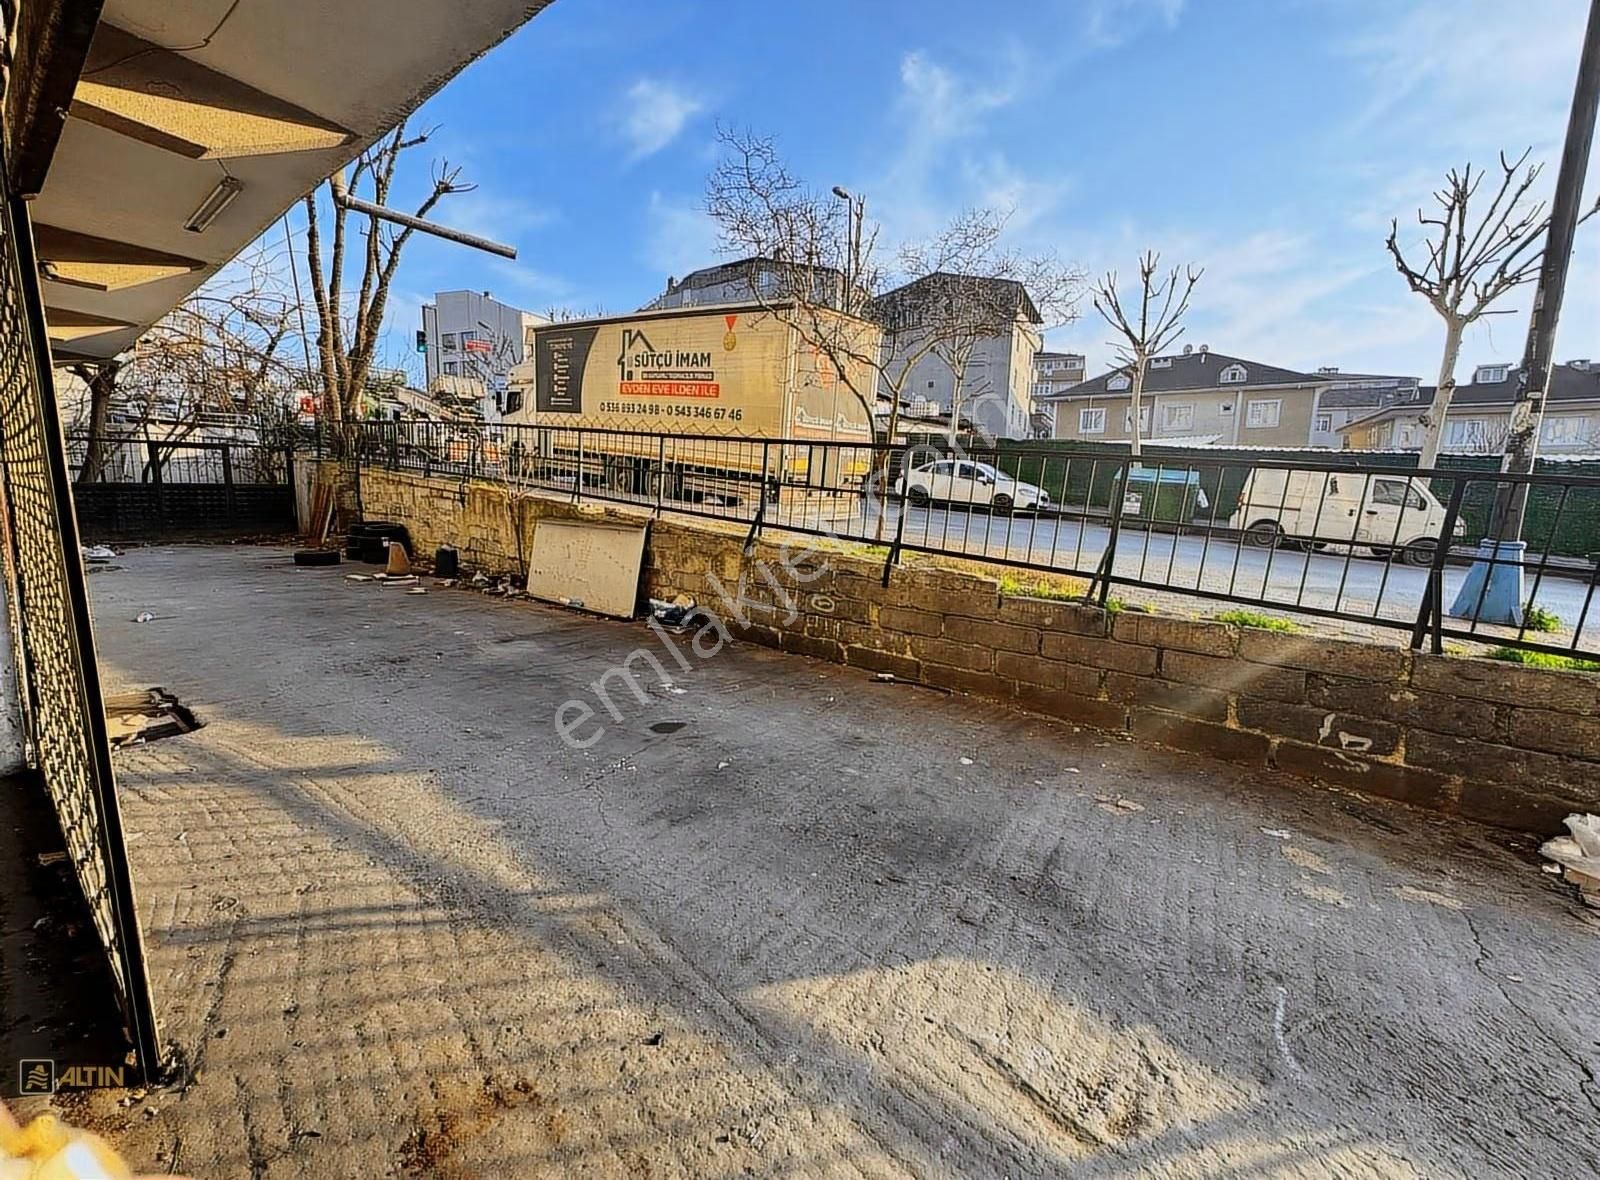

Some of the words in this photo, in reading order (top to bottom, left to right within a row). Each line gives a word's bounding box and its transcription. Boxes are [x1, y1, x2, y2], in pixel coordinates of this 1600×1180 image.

[634, 350, 672, 370] SÜTÇÜ
[676, 350, 711, 367] İMAM
[674, 405, 692, 417] 543
[693, 406, 712, 419] 346
[713, 407, 726, 420] 67
[728, 408, 742, 421] 46
